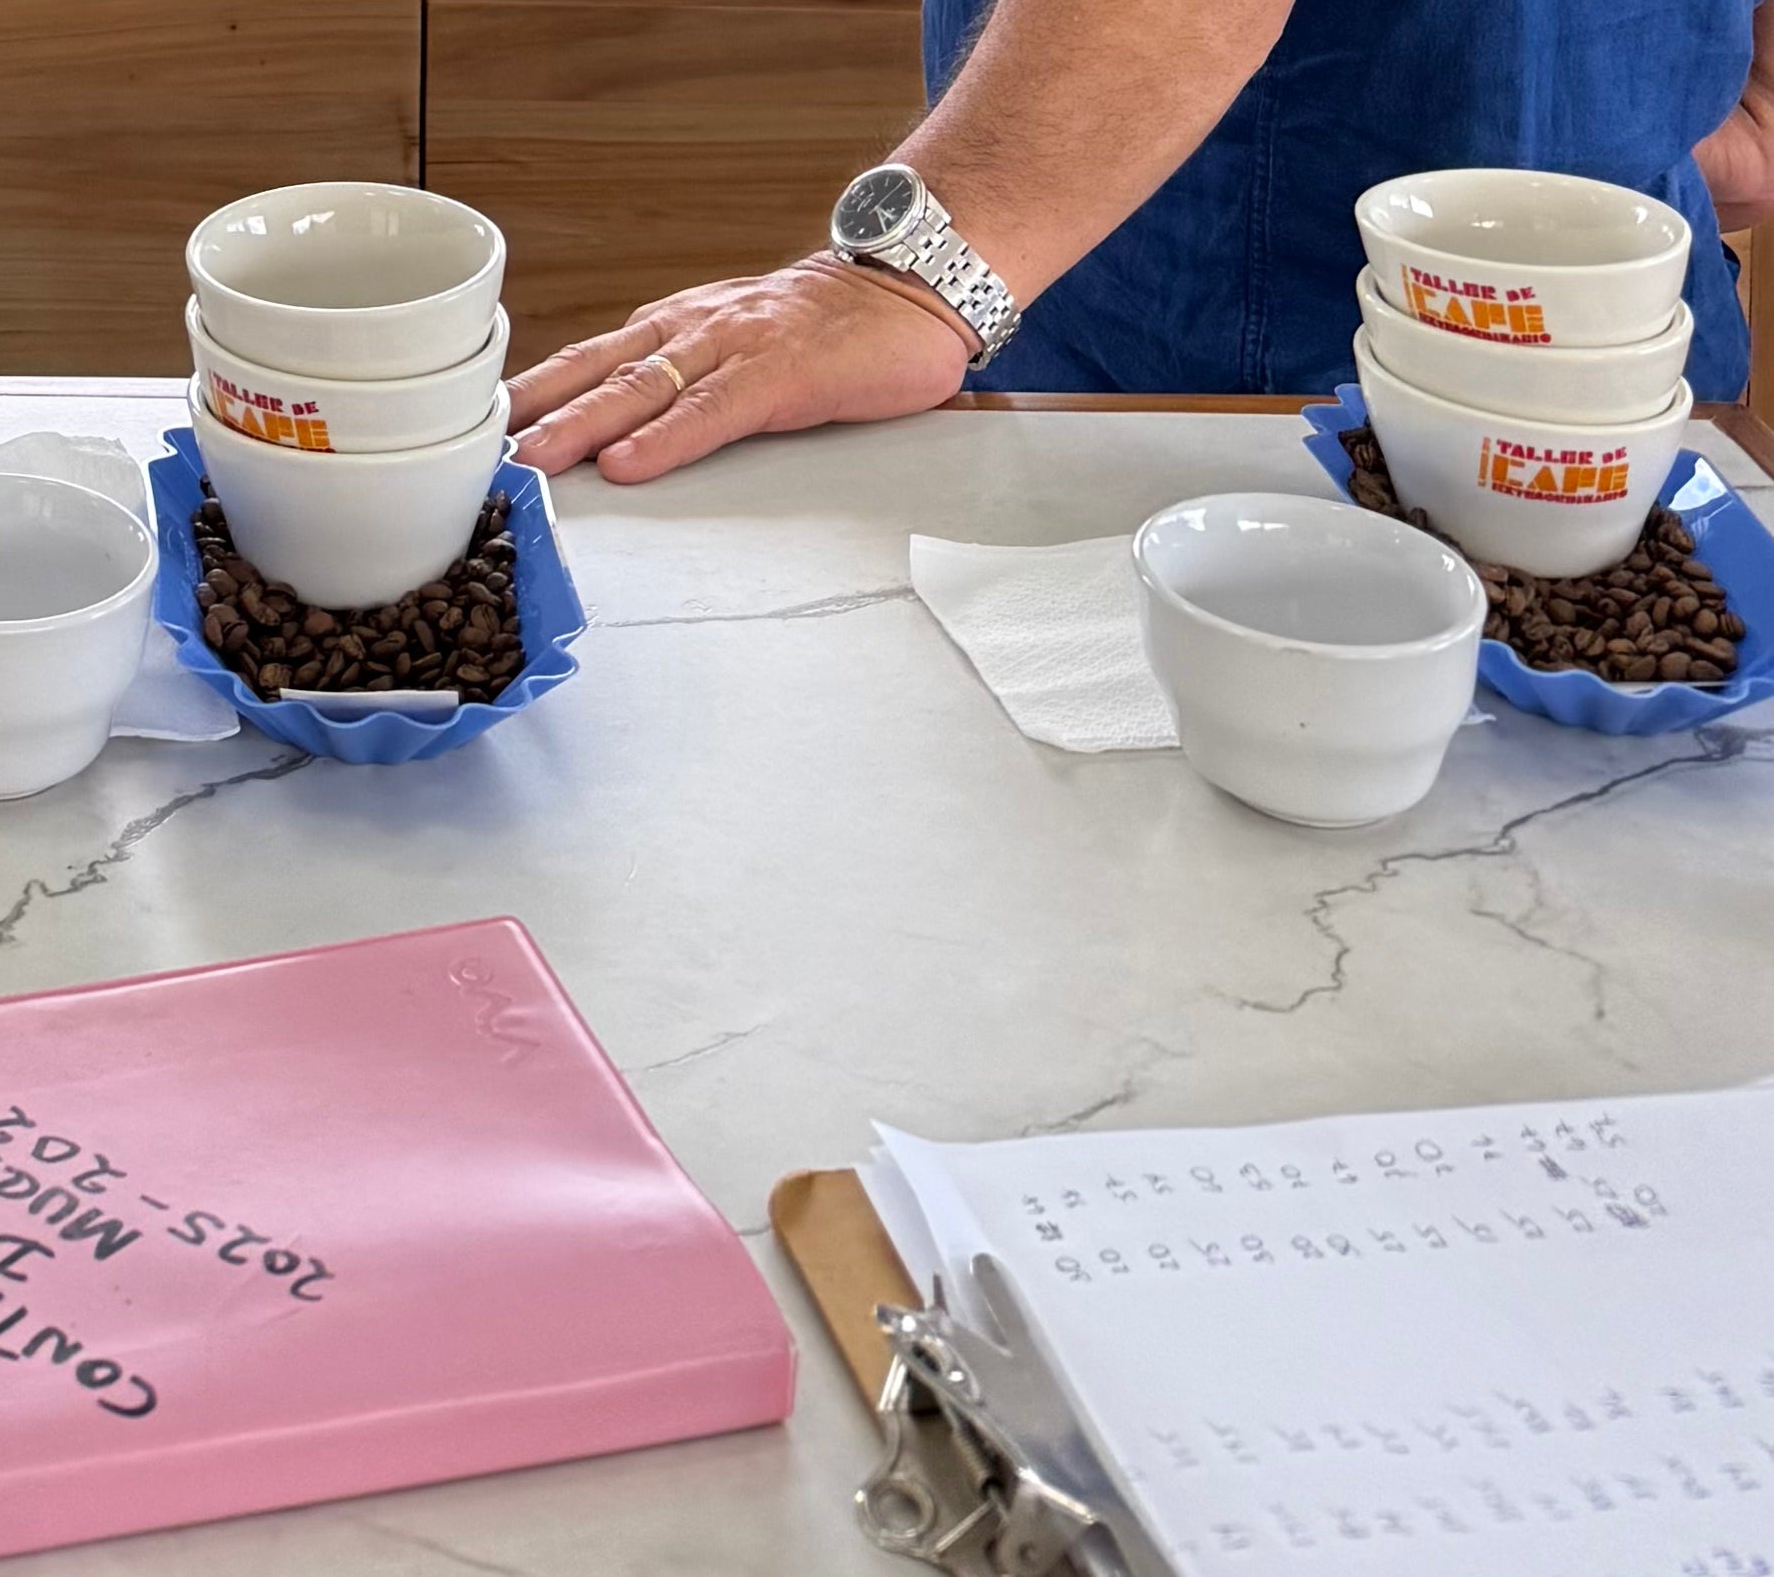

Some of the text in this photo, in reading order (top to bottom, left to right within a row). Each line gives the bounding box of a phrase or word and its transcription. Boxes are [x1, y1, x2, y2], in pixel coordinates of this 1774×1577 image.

[1409, 267, 1536, 303] TALLER DE
[212, 371, 320, 416] TALLER DE
[1496, 438, 1628, 465] TALLER DE
